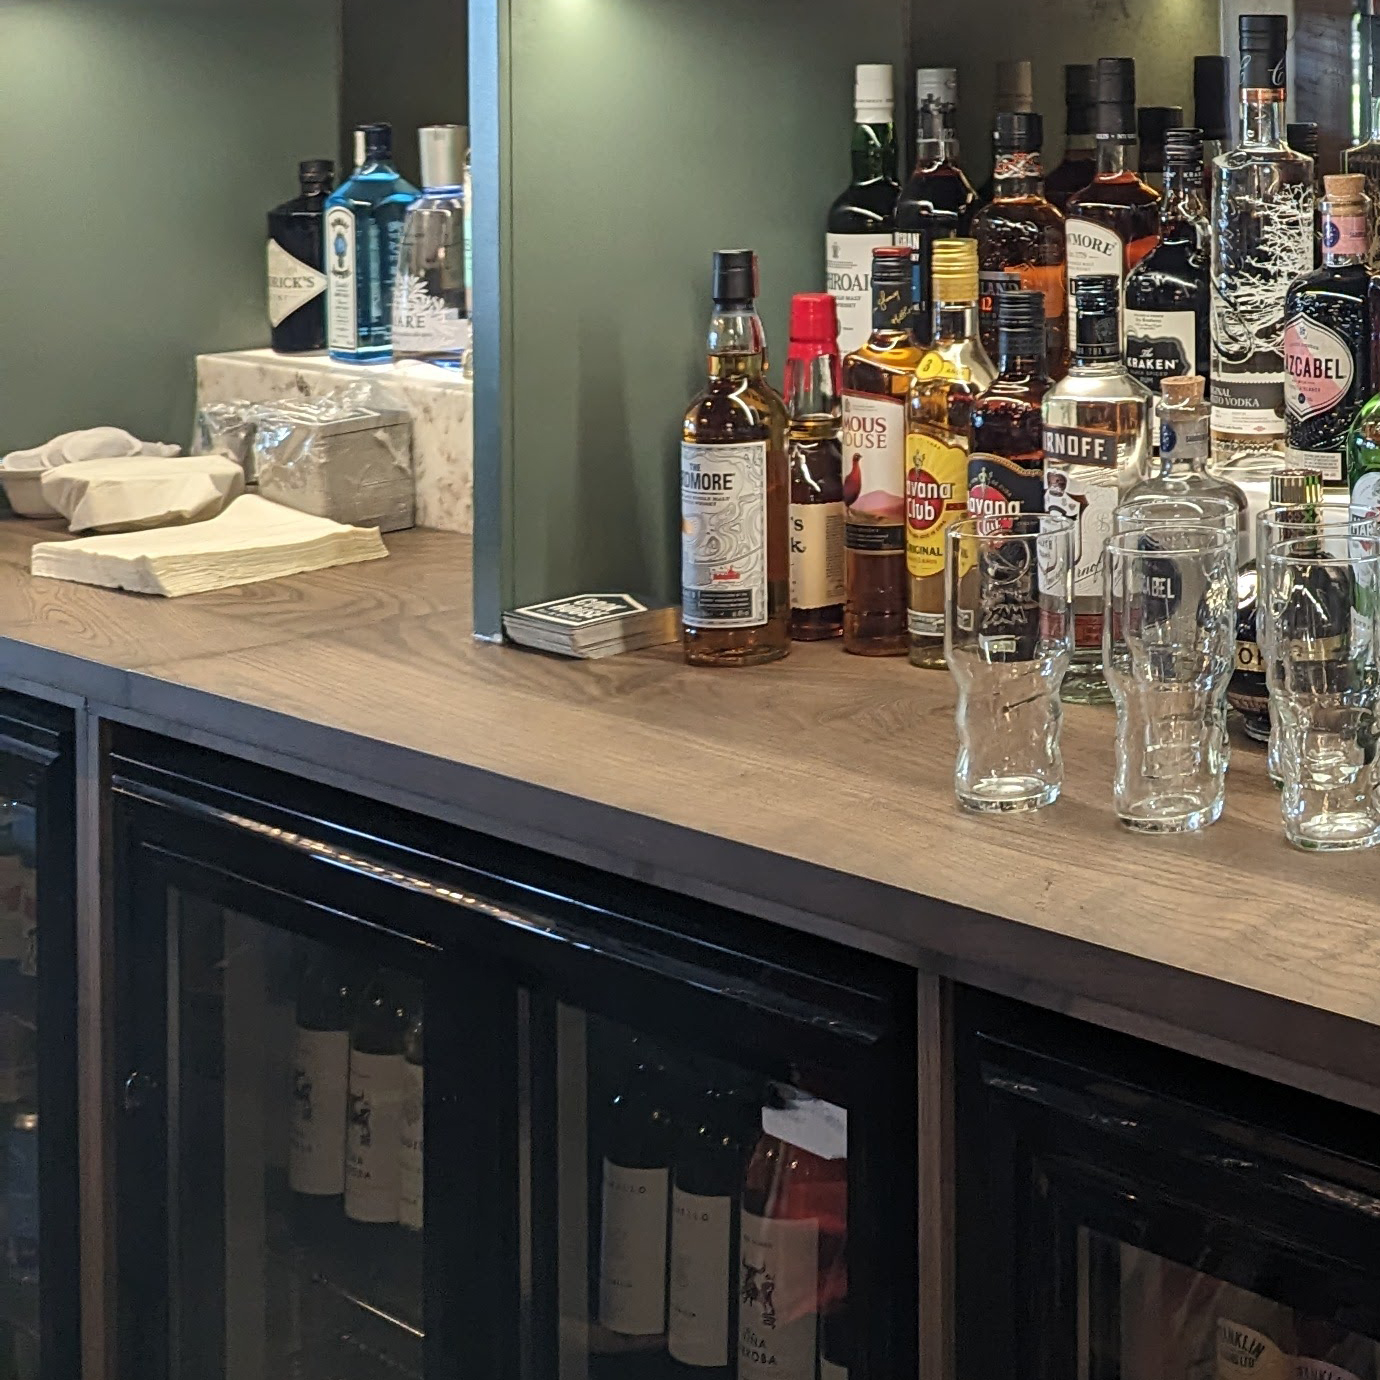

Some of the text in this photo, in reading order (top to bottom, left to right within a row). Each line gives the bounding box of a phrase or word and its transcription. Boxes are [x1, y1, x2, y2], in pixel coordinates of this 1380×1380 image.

[922, 358, 932, 371] 3
[1127, 357, 1177, 370] KRAKEN
[1225, 397, 1260, 408] VODKA
